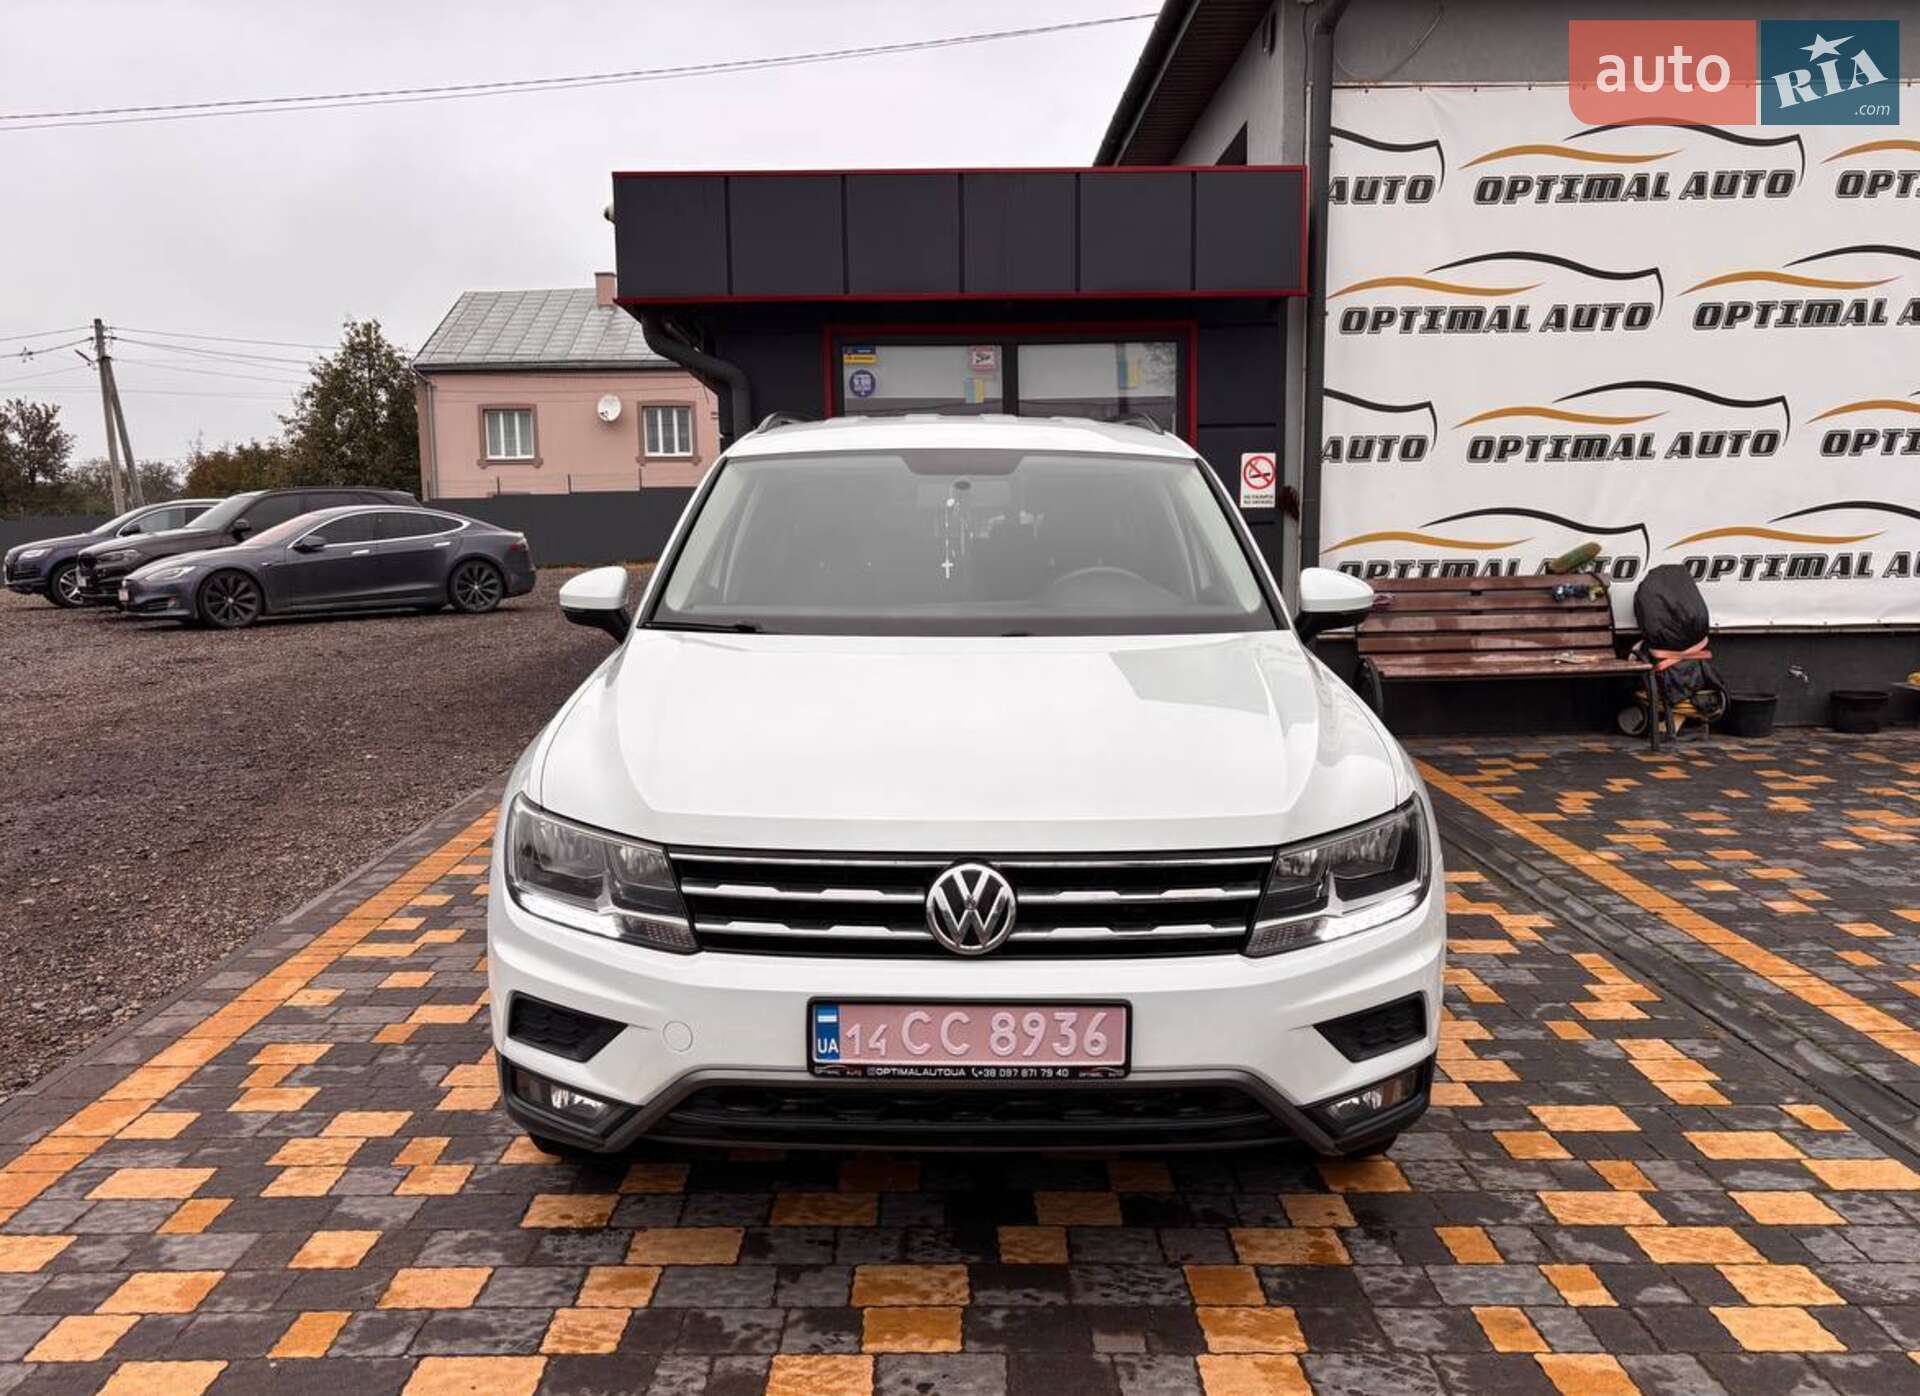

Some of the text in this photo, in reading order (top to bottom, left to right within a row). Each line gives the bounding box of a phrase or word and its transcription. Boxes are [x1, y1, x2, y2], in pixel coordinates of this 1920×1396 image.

[1328, 175, 1436, 205] AUTO
[1473, 169, 1796, 205] OPTIMAL AUTO
[1835, 170, 1920, 198] OPT
[1339, 302, 1655, 335] OPTIMAL AUTO
[1692, 298, 1888, 330] OPTIMAL
[1321, 435, 1429, 463] AUTO
[1466, 429, 1781, 463] OPTIMAL AUTO
[1681, 552, 1873, 582] OPTIMAL
[925, 863, 1016, 955] VW
[818, 1038, 839, 1054] UA
[846, 1011, 1108, 1056] 14 CC 8936
